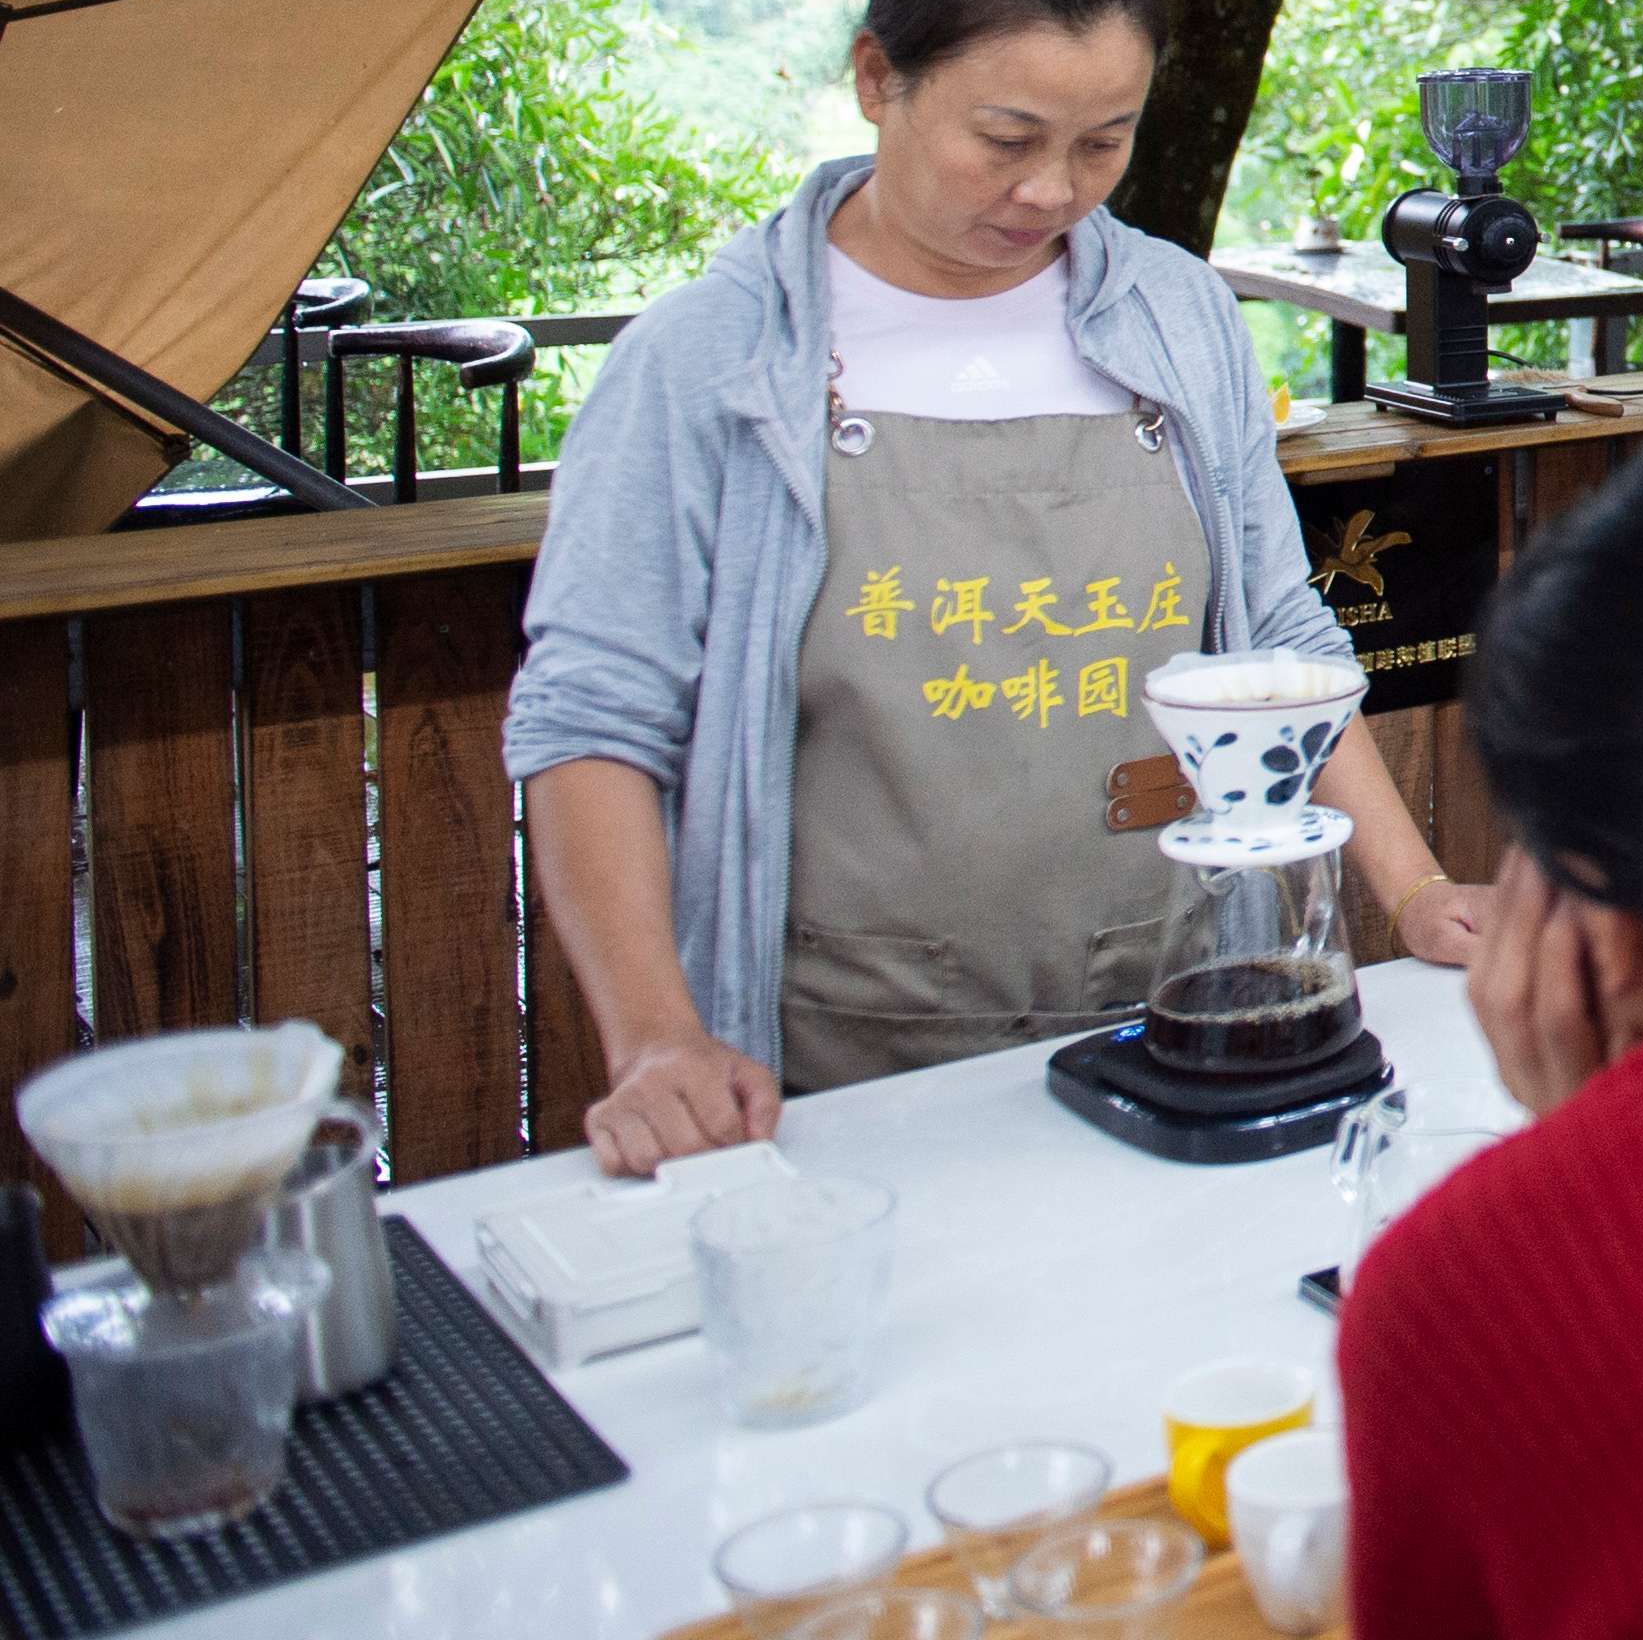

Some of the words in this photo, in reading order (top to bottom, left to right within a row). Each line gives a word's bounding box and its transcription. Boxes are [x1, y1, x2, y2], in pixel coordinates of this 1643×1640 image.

[845, 559, 1191, 646] 普洱天玉庄
[1336, 601, 1394, 627] ISHA
[921, 656, 1130, 730] 咖啡园
